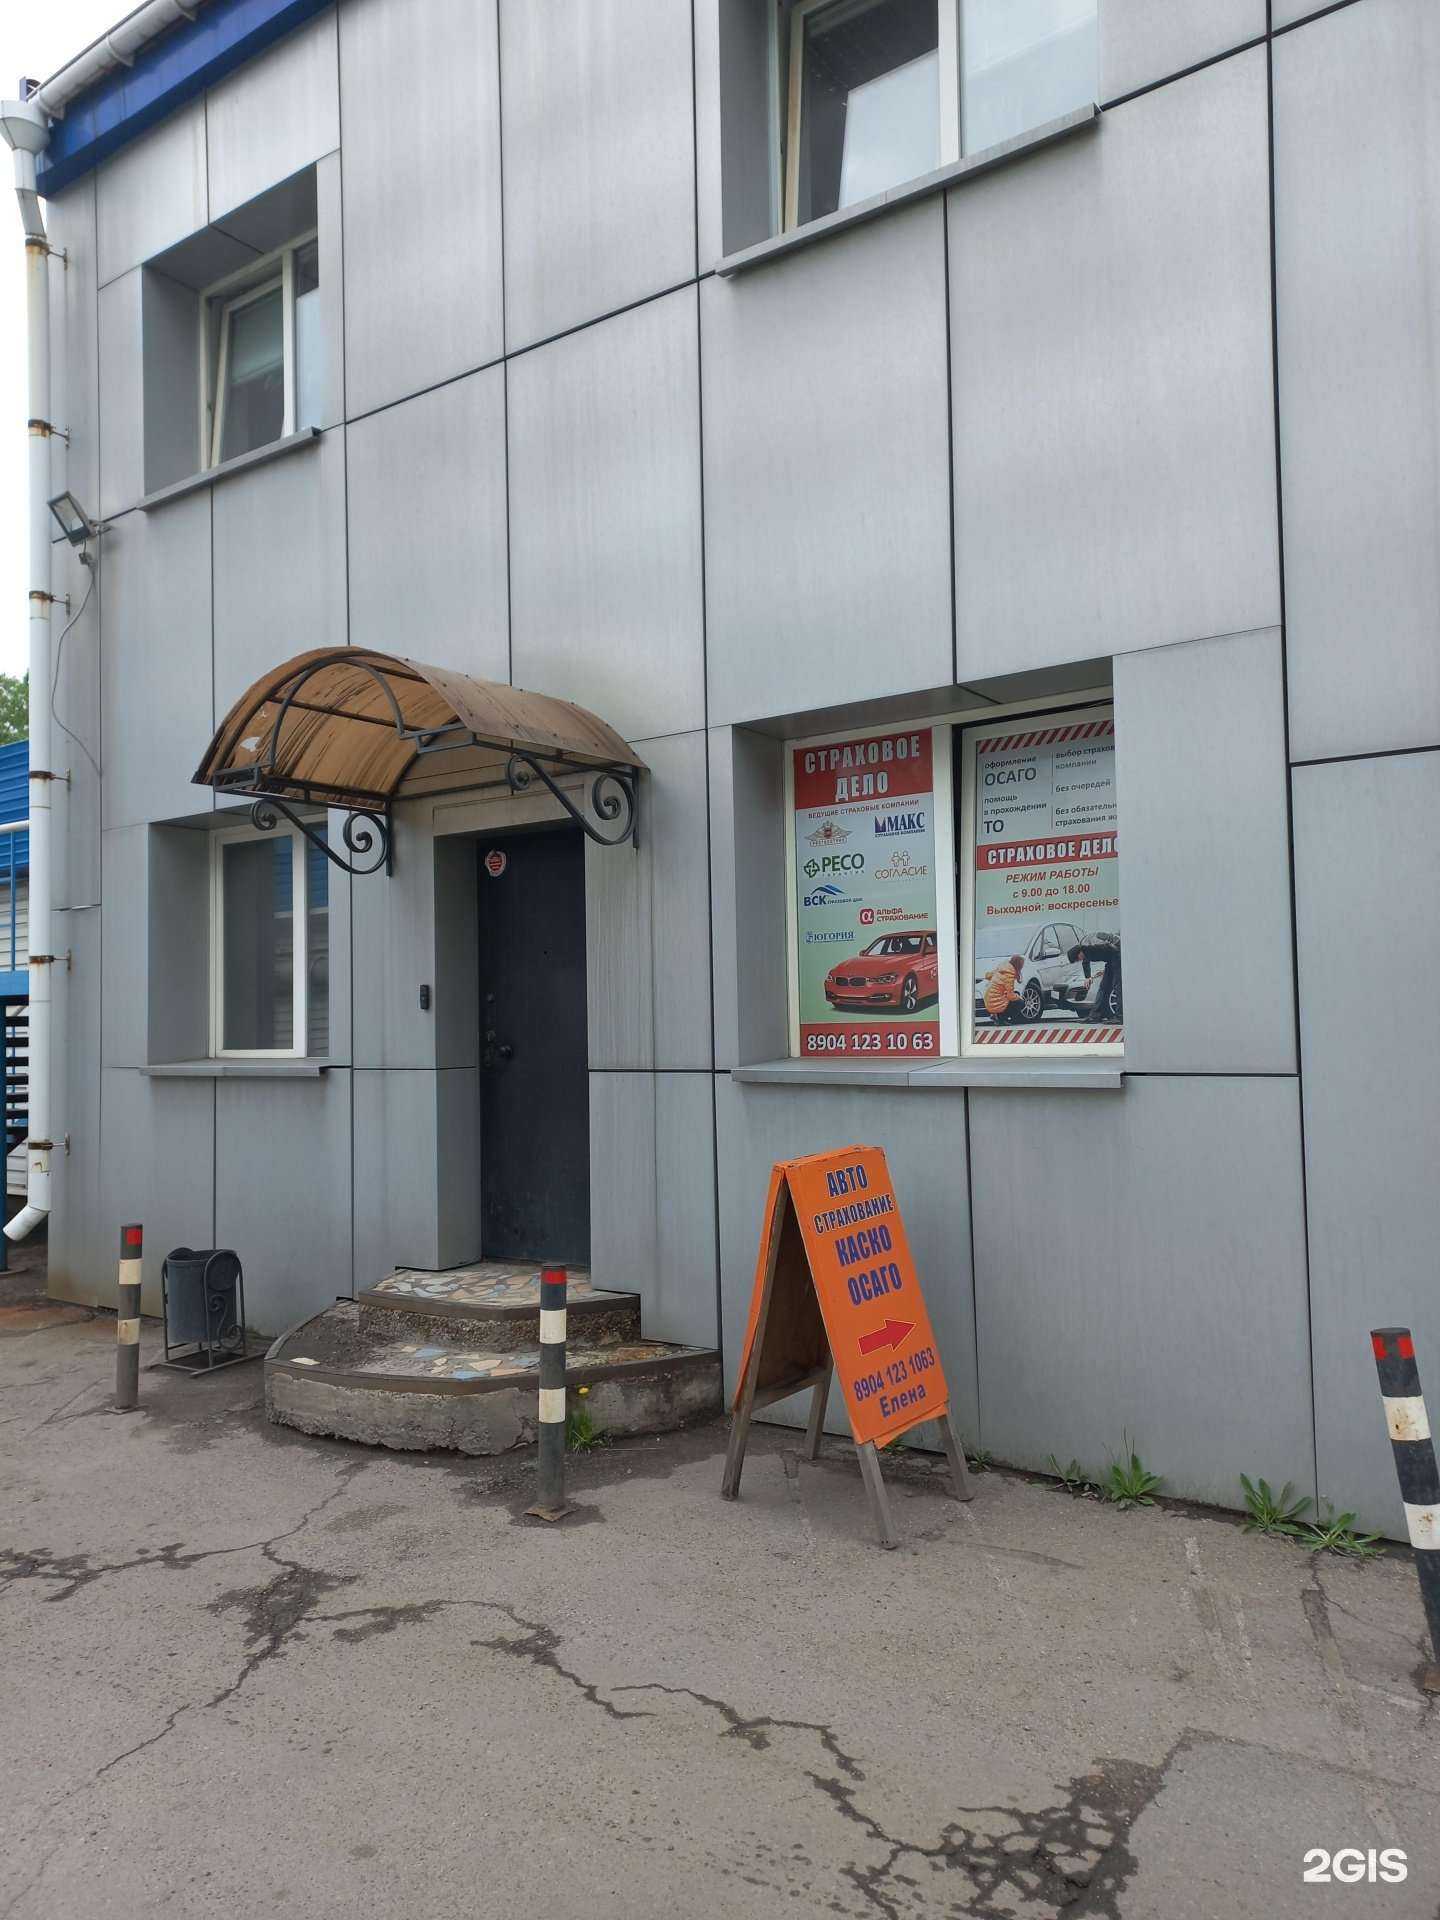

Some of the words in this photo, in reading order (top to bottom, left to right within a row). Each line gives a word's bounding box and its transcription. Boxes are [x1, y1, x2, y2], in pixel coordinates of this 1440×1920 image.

[805, 735, 920, 774] СТРАХОВОЕ
[984, 755, 1037, 770] оформление
[1055, 749, 1082, 759] выбор
[984, 767, 1037, 787] ОСАГО
[1055, 783, 1070, 793] без
[1071, 778, 1111, 792] очередей
[835, 771, 889, 803] ДЕЛО
[984, 794, 1018, 805] помощь
[990, 802, 1047, 815] прохождении
[808, 809, 839, 819] ВЕДУЩИЕ
[840, 804, 880, 815] СТРАХОВЫЕ
[881, 799, 920, 810] КОМПАНИИ
[1055, 807, 1070, 816] без
[887, 812, 925, 832] МАКС
[983, 819, 1005, 834] ТО
[1055, 815, 1106, 828] страхования
[987, 841, 1076, 865] СТРАХОВОЕ
[822, 853, 865, 873] РЕСО
[874, 865, 929, 880] СОГЛАСИЕ
[1005, 871, 1047, 884] РЕЖИМ
[1049, 866, 1100, 881] РАБОТЫ
[1012, 890, 1019, 899] с
[1021, 887, 1043, 898] 9.00
[1044, 888, 1059, 897] до
[1062, 883, 1090, 896] 18.00
[803, 895, 827, 907] ВСК
[986, 903, 1045, 916] Выходной:
[1048, 897, 1120, 912] воскресенье
[876, 907, 903, 916] АЛЬФА
[876, 912, 929, 922] СТРАХОВАНИЕ
[814, 930, 854, 941] ЮГОРИЯ
[807, 1034, 847, 1051] 8904
[851, 1034, 881, 1050] 123
[887, 1033, 908, 1050] 10
[912, 1033, 934, 1050] 63
[826, 1164, 868, 1198] АВТО
[814, 1193, 895, 1235] СТРАХОВАНИЕ
[835, 1224, 893, 1266] КАСКО
[847, 1262, 903, 1306] ОСАГО
[854, 1370, 885, 1402] 8904
[886, 1359, 908, 1387] 123
[909, 1346, 936, 1375] 1063
[879, 1383, 927, 1418] Елена
